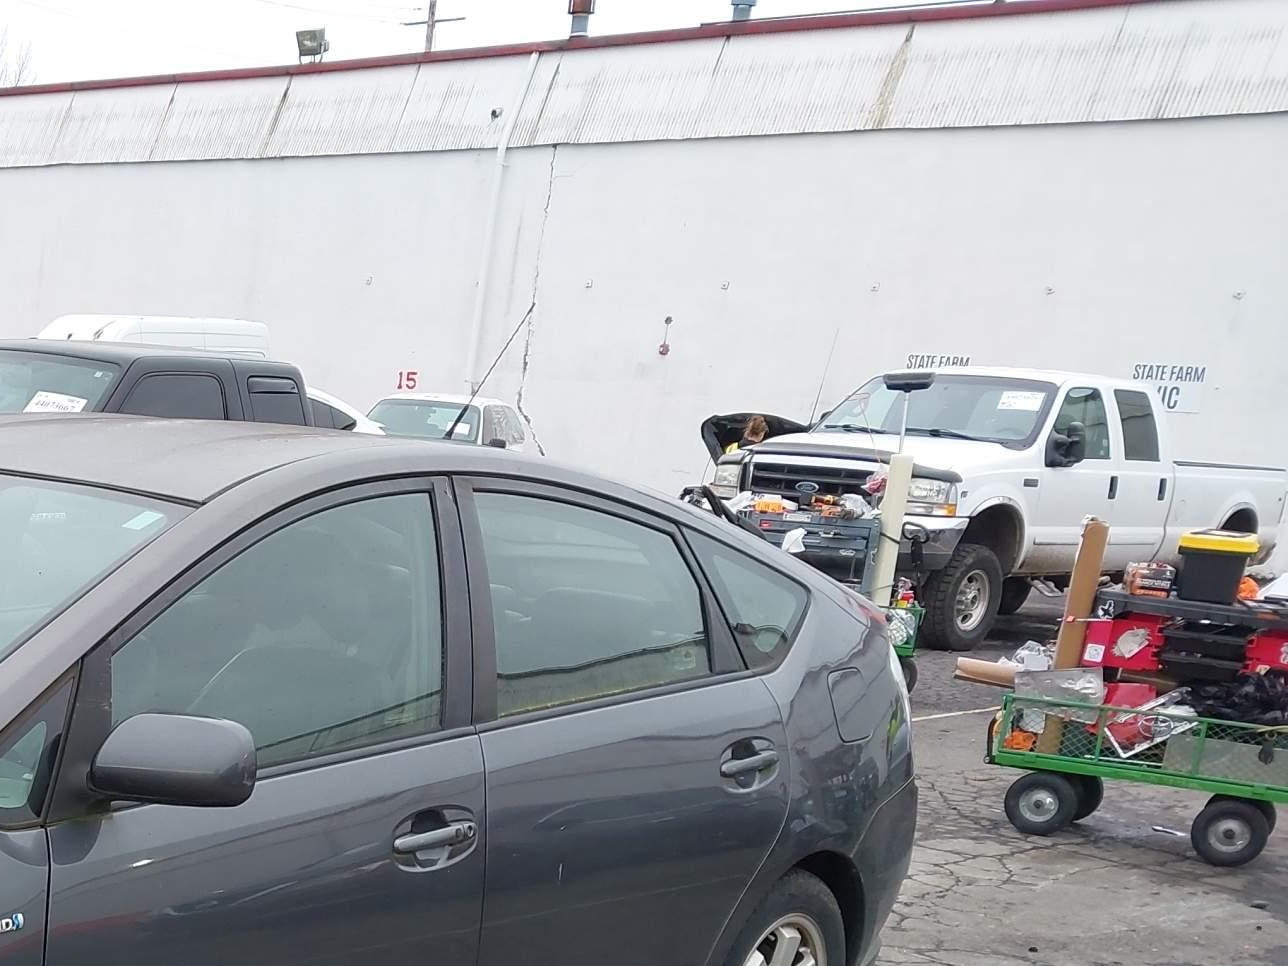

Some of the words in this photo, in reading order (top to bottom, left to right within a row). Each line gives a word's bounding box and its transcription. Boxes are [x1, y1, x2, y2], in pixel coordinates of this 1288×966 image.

[906, 353, 938, 369] STATE
[938, 355, 971, 368] FARM
[396, 370, 418, 390] 15
[1132, 363, 1168, 381] STATE
[1168, 365, 1207, 383] FARM
